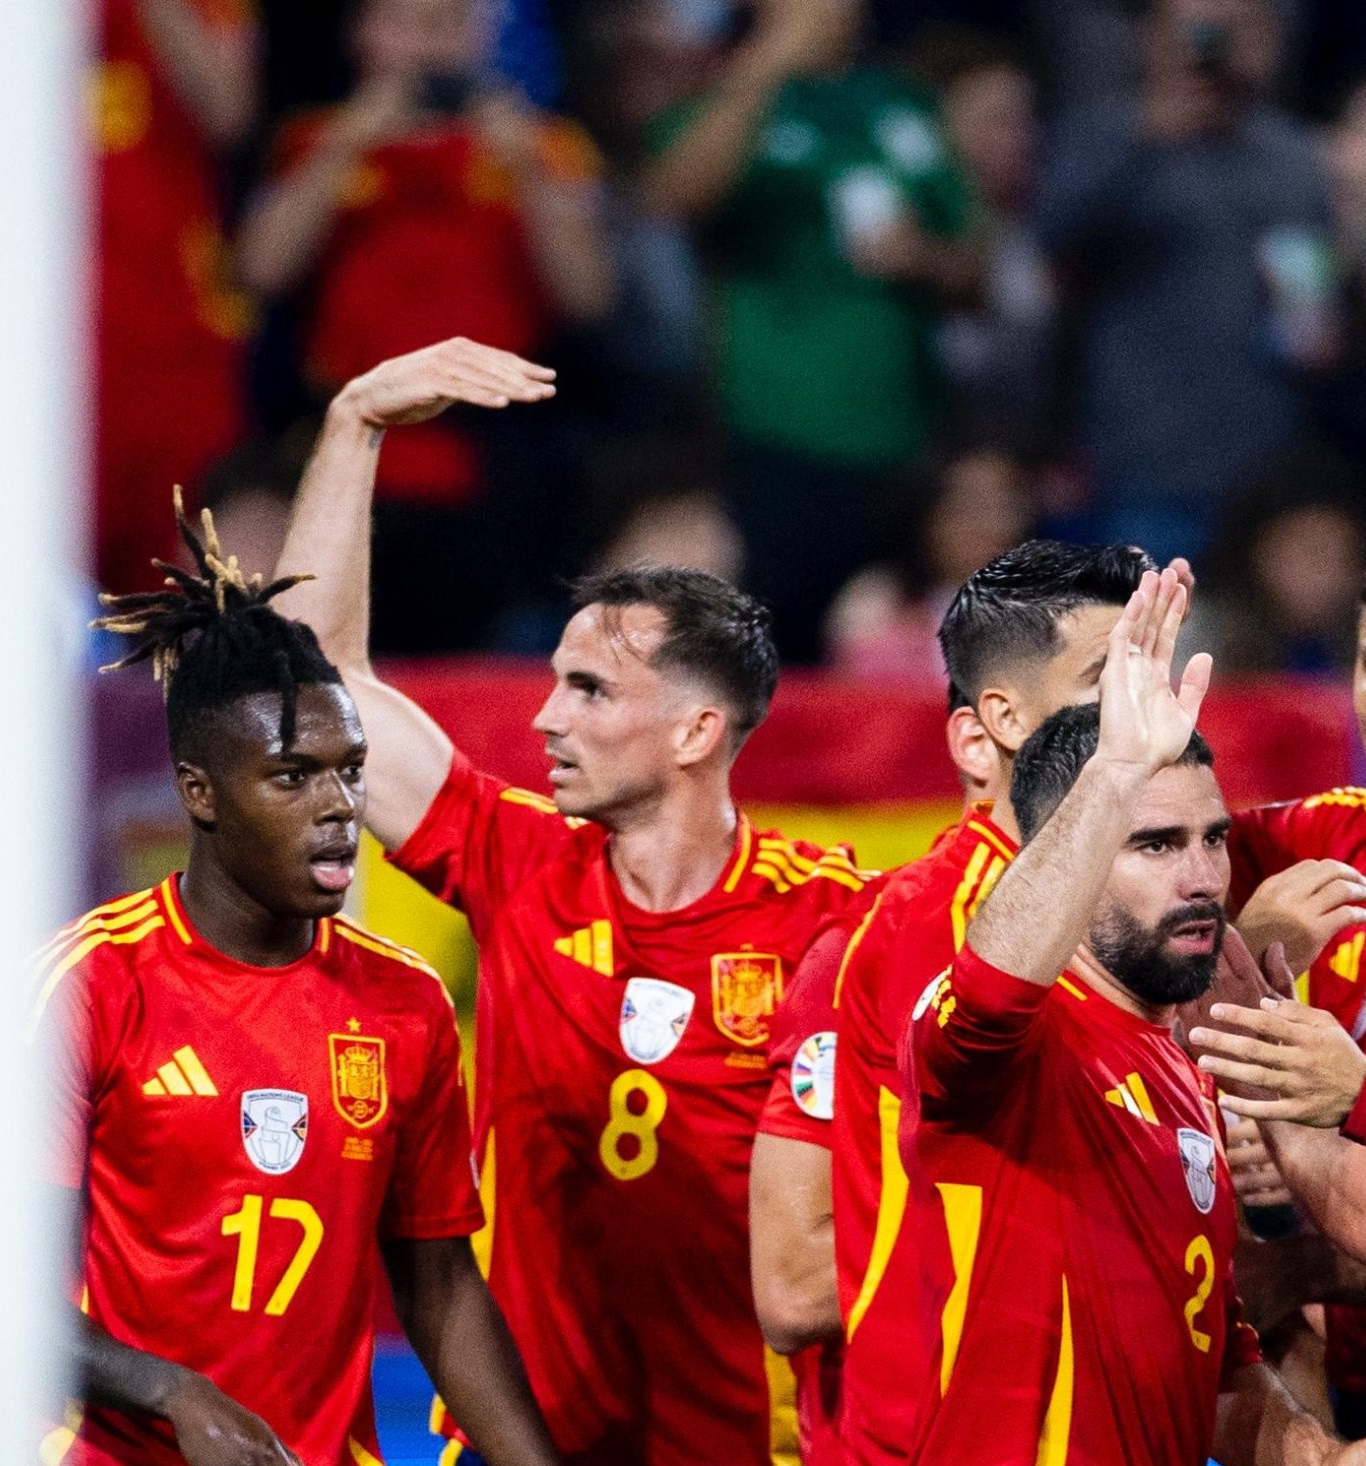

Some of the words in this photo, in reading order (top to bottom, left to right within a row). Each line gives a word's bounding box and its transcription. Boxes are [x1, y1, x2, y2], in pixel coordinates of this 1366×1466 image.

[599, 1069, 667, 1180] 8
[221, 1195, 324, 1316] 17
[1184, 1234, 1215, 1353] 2
